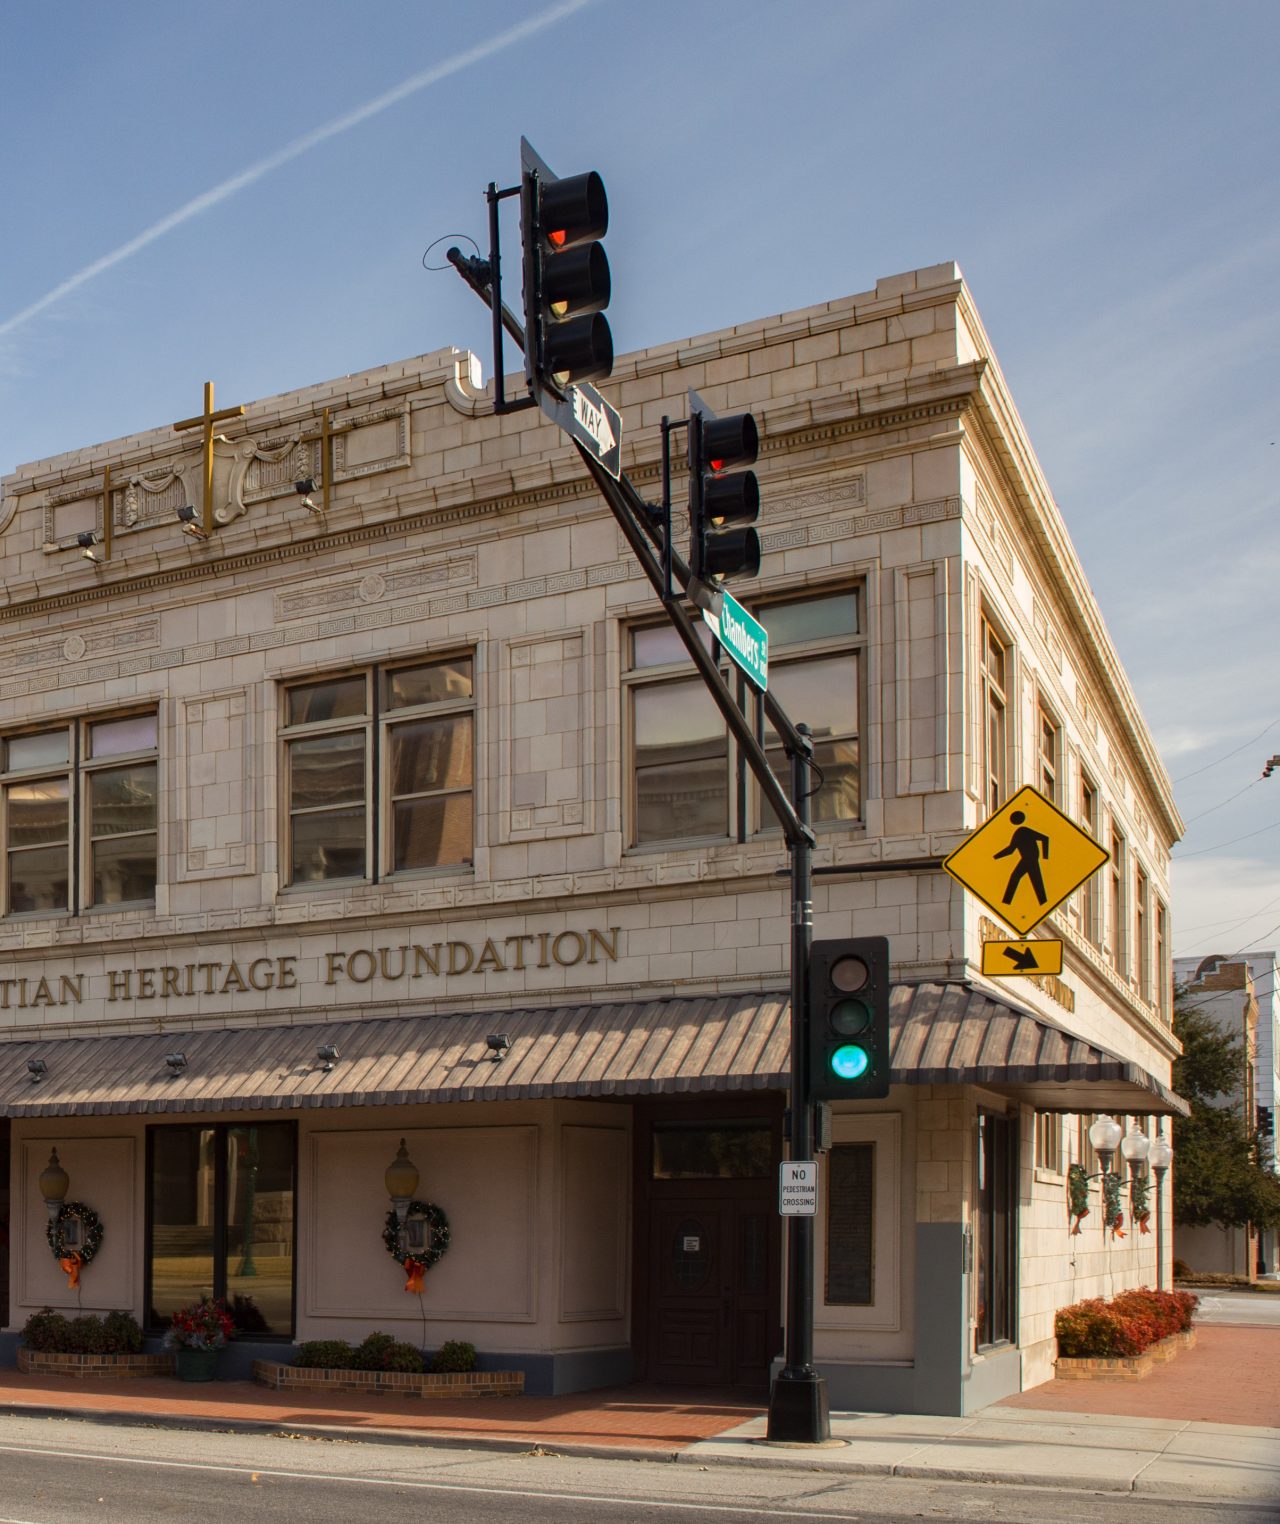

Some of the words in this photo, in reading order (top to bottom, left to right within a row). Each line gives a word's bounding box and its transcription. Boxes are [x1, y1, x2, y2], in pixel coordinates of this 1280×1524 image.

[581, 397, 602, 438] WAY
[721, 602, 759, 670] Chambers
[107, 956, 298, 1001] HERITAGE
[324, 926, 621, 985] FOUNDATION
[792, 1170, 806, 1180] NO
